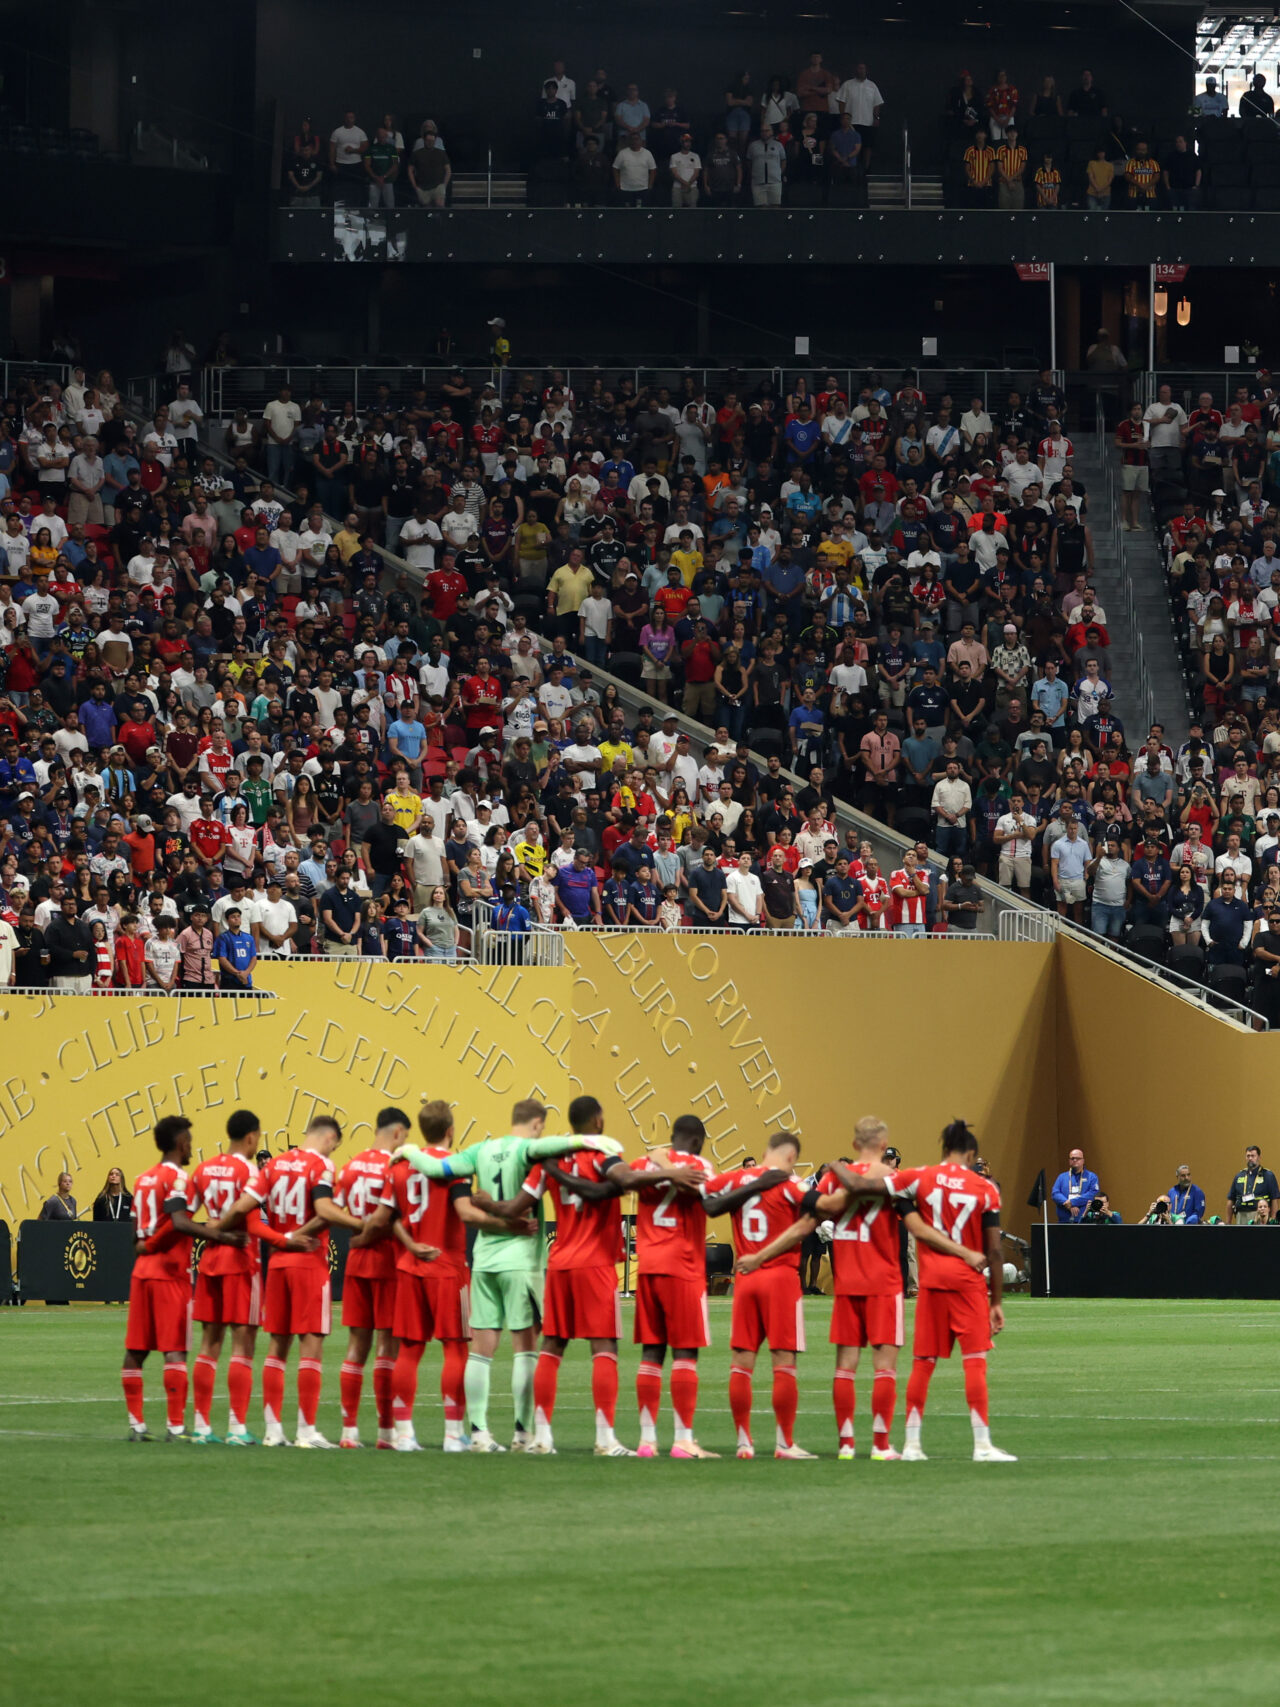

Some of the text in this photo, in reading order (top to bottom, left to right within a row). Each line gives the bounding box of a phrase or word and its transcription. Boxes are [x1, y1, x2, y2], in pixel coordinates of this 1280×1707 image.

[1029, 263, 1047, 273] 134
[1157, 264, 1175, 274] 134
[805, 678, 814, 687] 20
[841, 890, 850, 899] 10
[236, 948, 247, 958] 10
[268, 1175, 307, 1225] 44
[347, 1176, 385, 1221] 45
[406, 1173, 429, 1223] 9
[492, 1168, 504, 1202] 1
[652, 1180, 678, 1227] 2
[936, 1173, 966, 1191] OLISE
[134, 1189, 157, 1239] 11
[742, 1194, 768, 1242] 6
[833, 1195, 886, 1243] 27
[925, 1187, 978, 1246] 17
